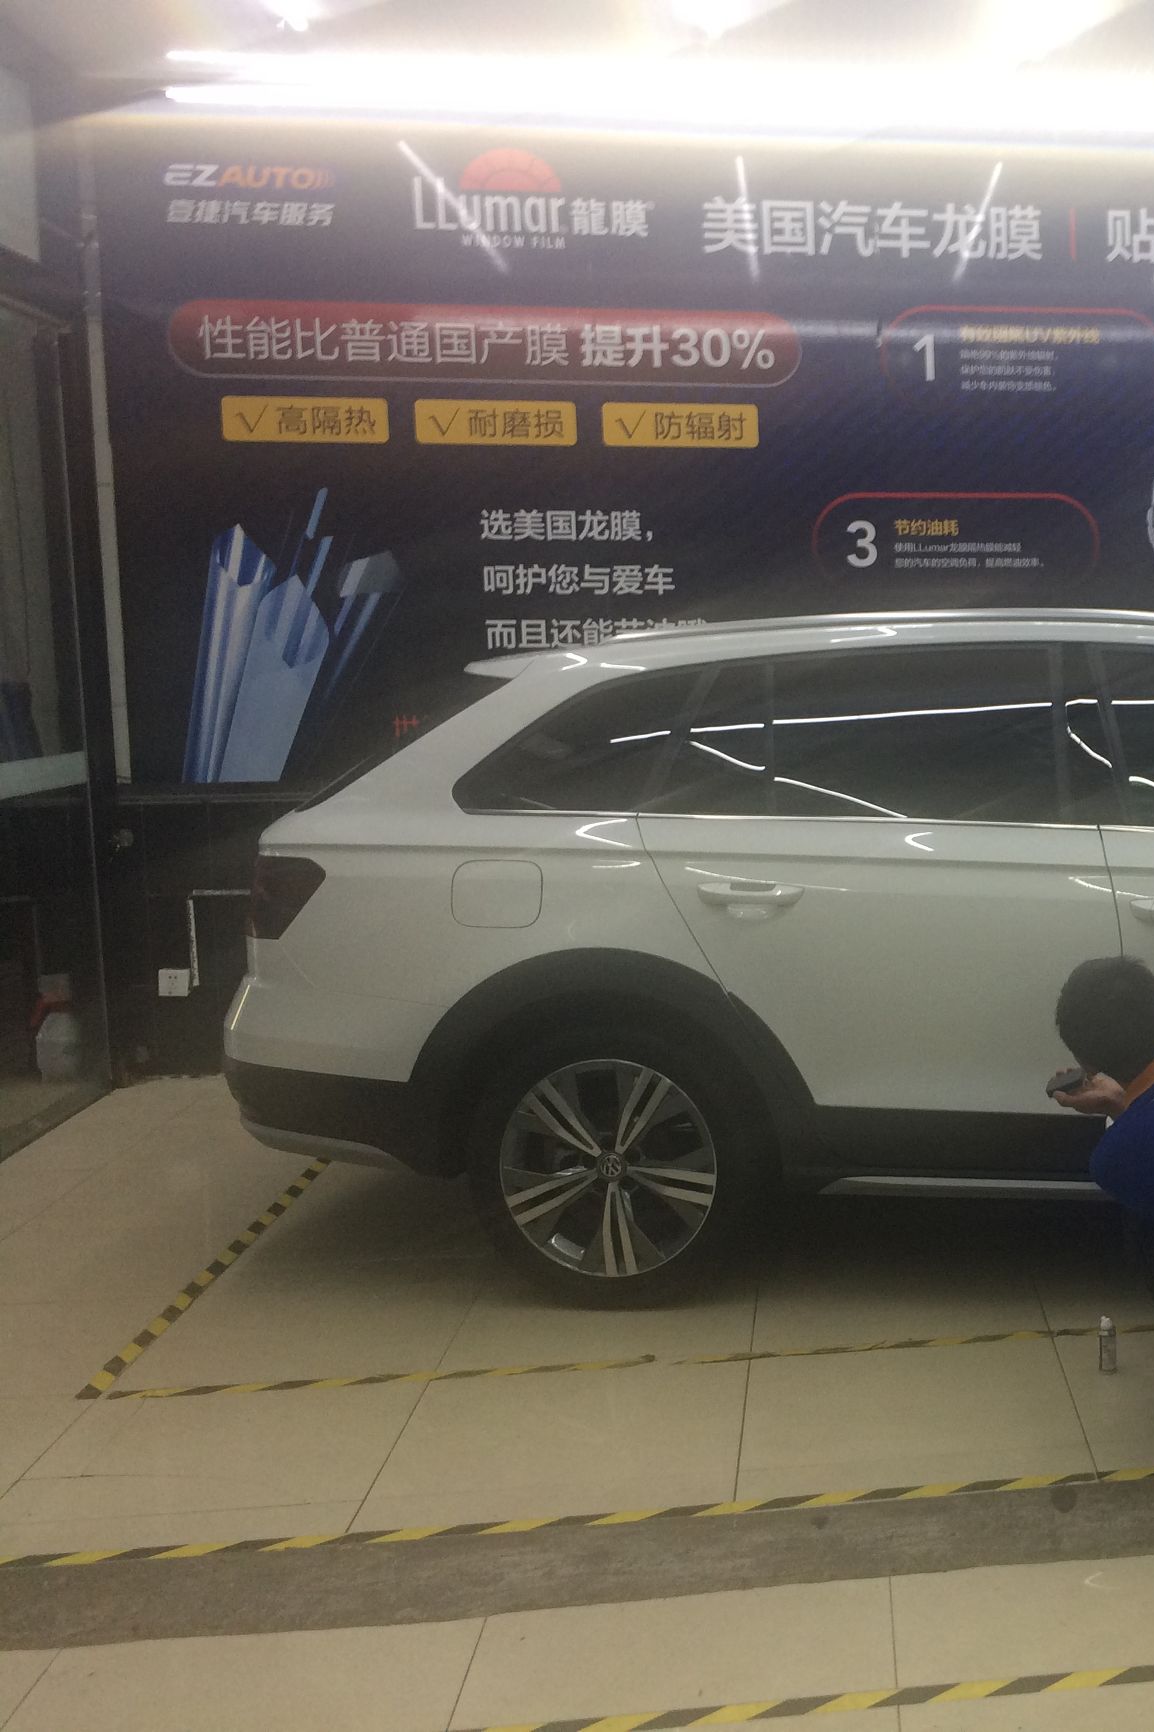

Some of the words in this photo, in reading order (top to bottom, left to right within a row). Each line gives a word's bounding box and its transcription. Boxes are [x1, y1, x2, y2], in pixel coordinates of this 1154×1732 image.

[413, 175, 566, 234] LLumar
[570, 198, 650, 237] 龍膜
[532, 236, 566, 249] FILM
[702, 197, 1042, 261] 美国汽车龙膜
[199, 315, 569, 366] 性能比普通国产膜
[580, 327, 776, 370] 提升30%
[913, 333, 936, 382] 1
[276, 405, 376, 437] 高隔热
[467, 408, 565, 439] 耐磨损
[654, 410, 747, 442] 防辐射
[846, 520, 878, 568] 3
[894, 519, 959, 537] 节约油耗
[483, 563, 676, 597] 呵护您与爱车
[486, 618, 706, 650] 而且还能
